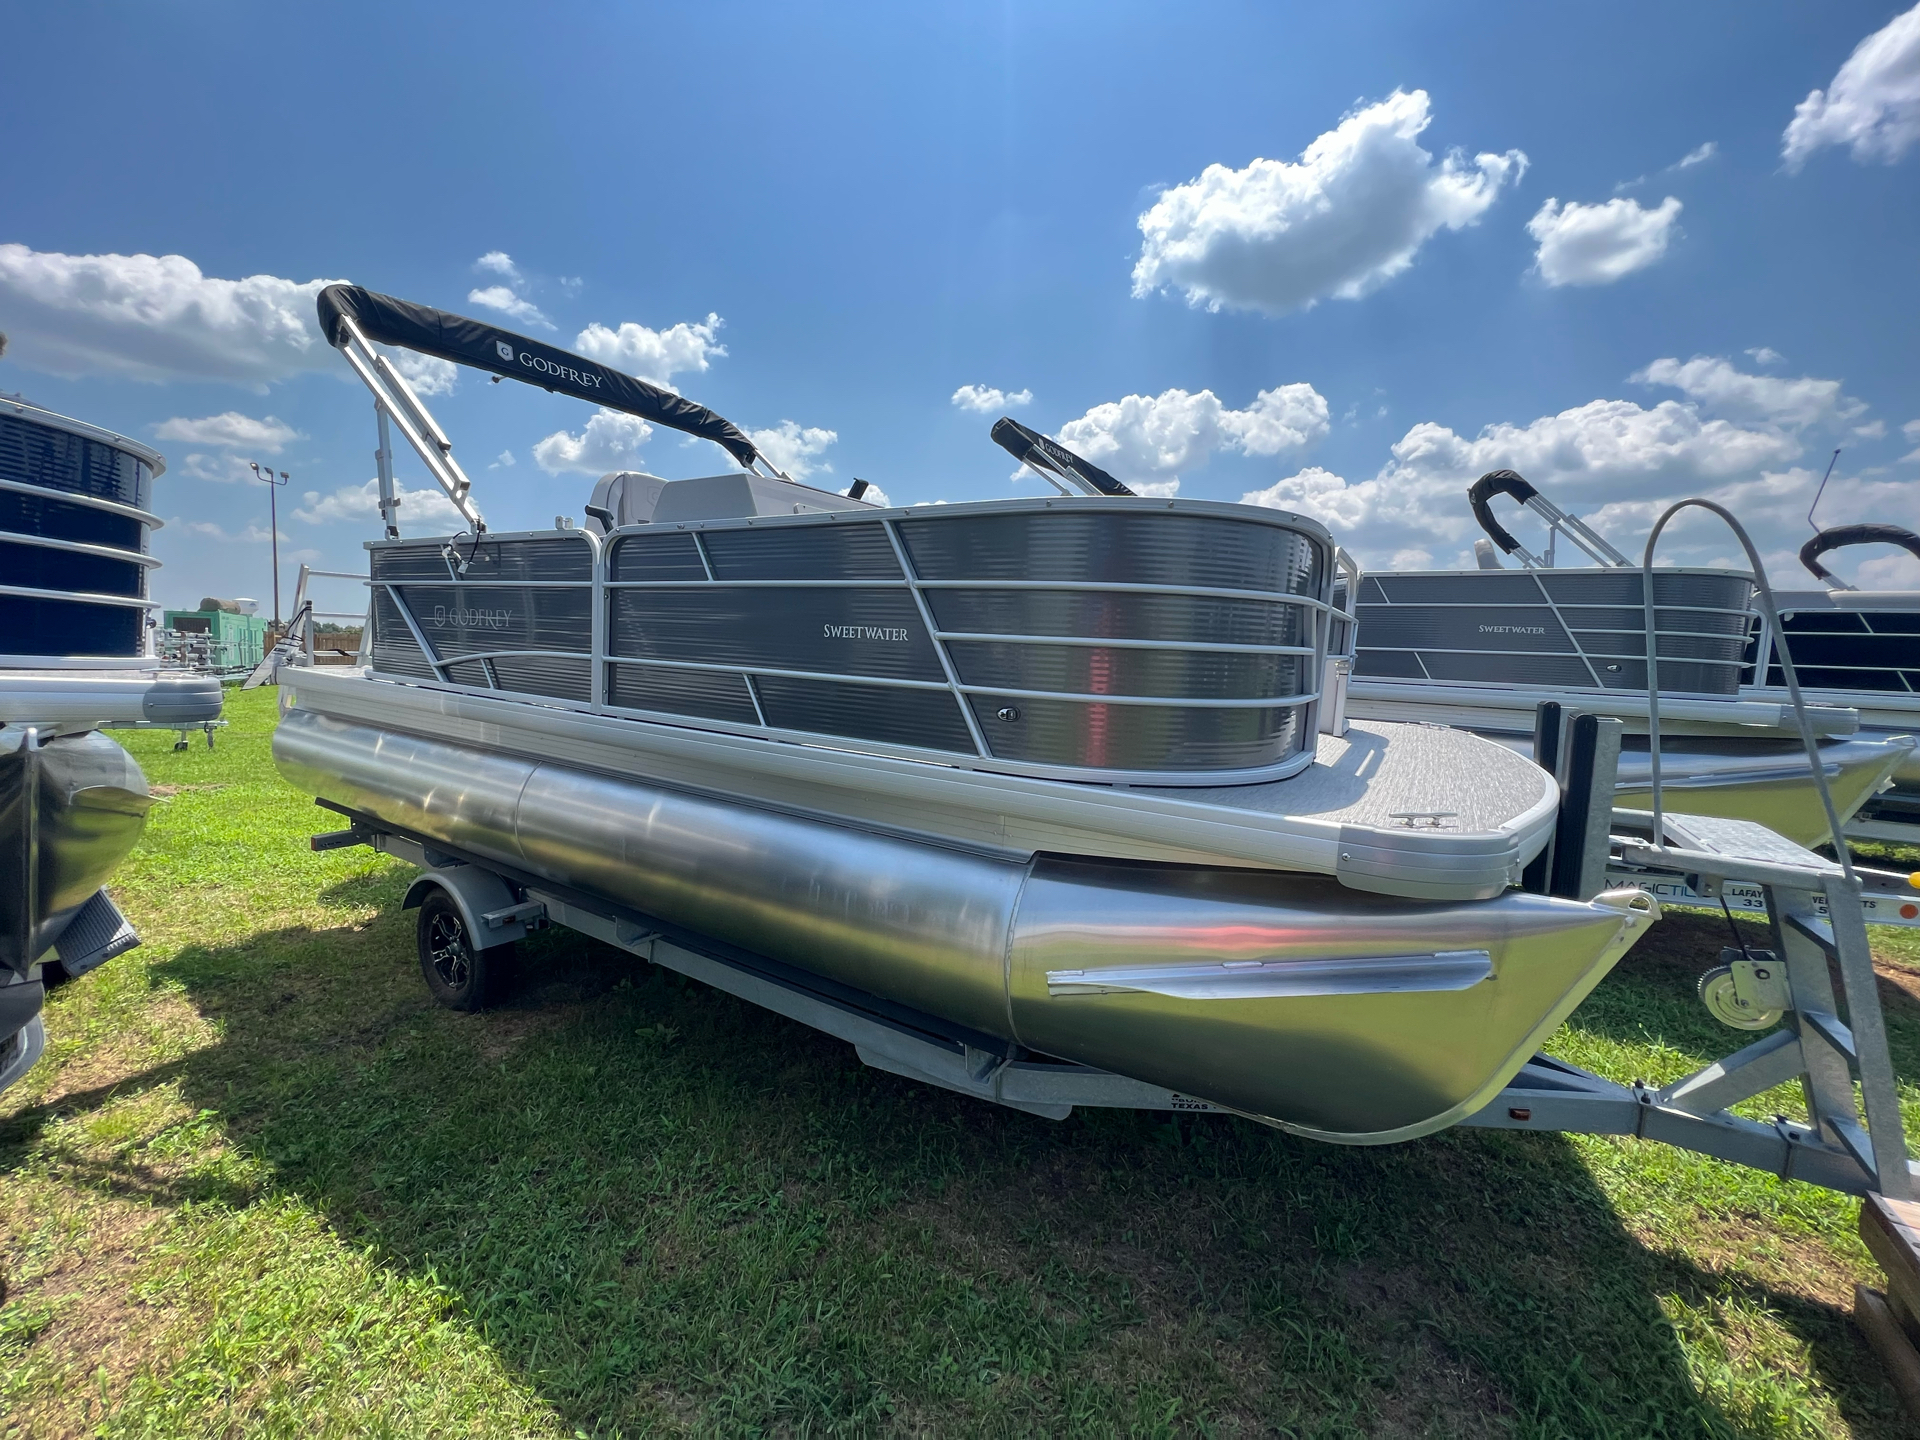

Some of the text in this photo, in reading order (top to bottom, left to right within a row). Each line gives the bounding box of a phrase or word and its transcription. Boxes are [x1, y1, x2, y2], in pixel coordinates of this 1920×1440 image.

[519, 352, 602, 388] GODFREY
[1045, 443, 1073, 463] GODFREY
[449, 607, 513, 630] GODFREY
[823, 623, 909, 641] SWEETWATER
[1478, 624, 1545, 635] SWEETWATER
[1604, 878, 1697, 898] MAGICTIL
[1743, 899, 1763, 908] 33
[1171, 1102, 1208, 1110] TEXAS
